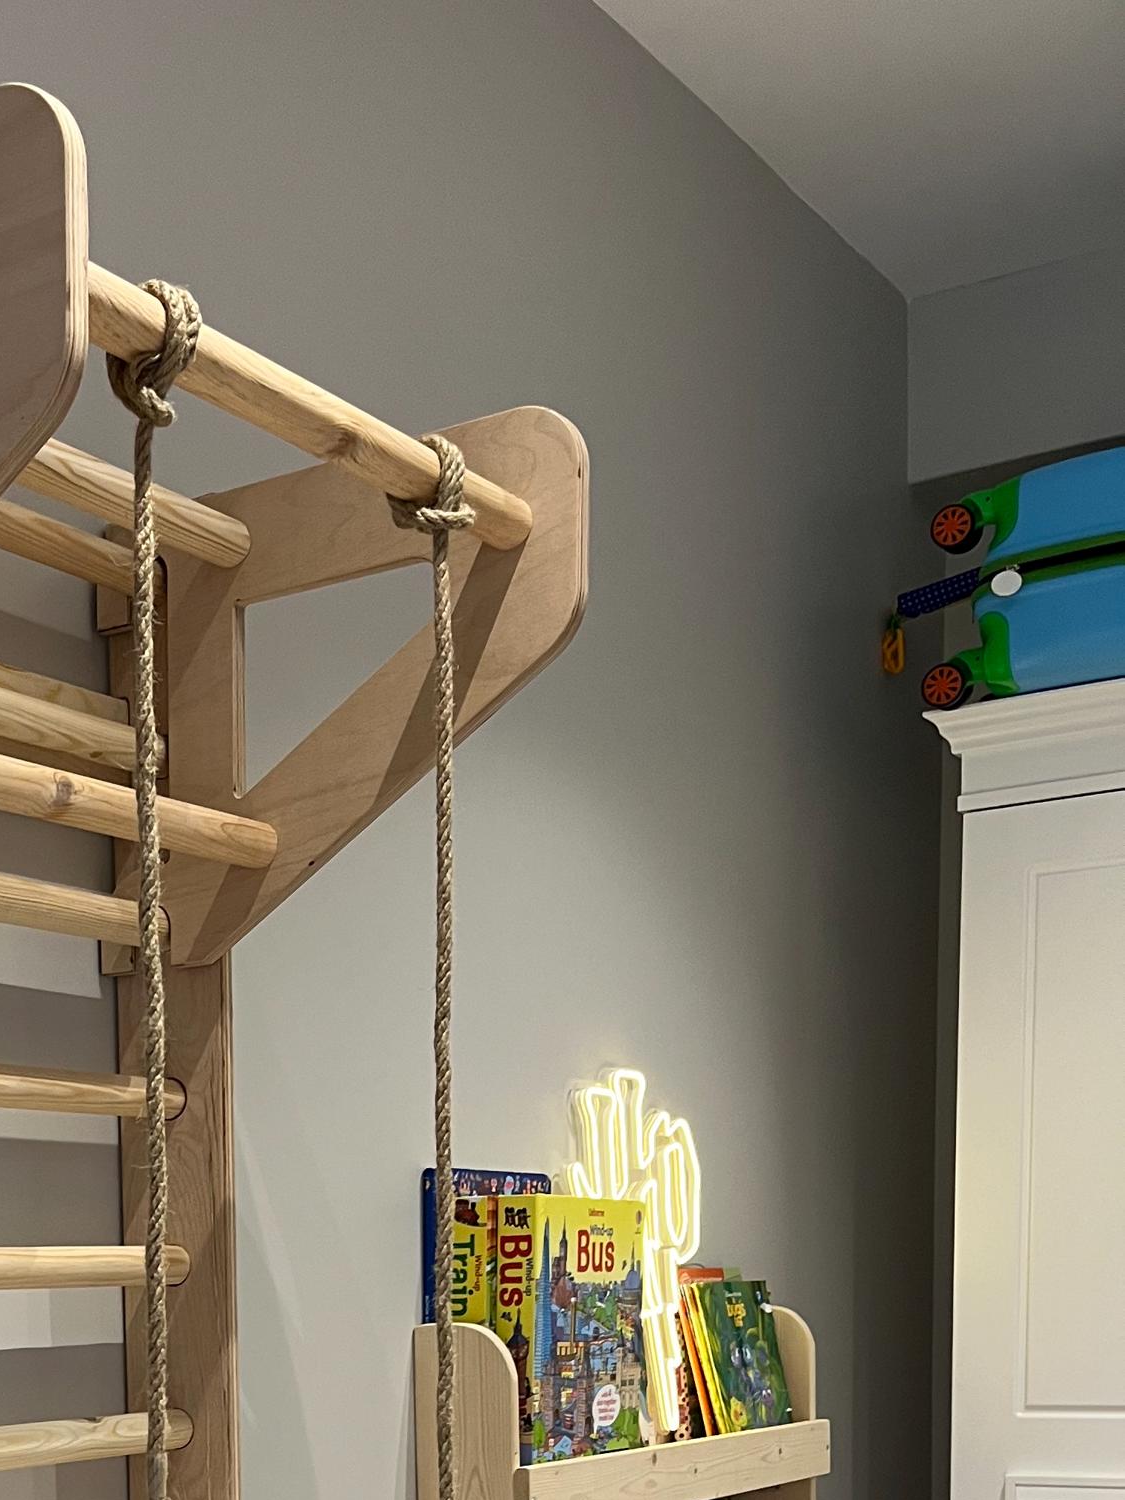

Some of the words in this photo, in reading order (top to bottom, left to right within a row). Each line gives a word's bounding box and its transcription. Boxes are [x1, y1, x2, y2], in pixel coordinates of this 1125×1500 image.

[577, 1229, 615, 1273] Bus
[590, 1223, 614, 1240] Wind-up
[451, 1234, 475, 1316] Train
[473, 1255, 483, 1292] Wind-up
[499, 1234, 533, 1307] Bus
[524, 1257, 534, 1297] Wind-up
